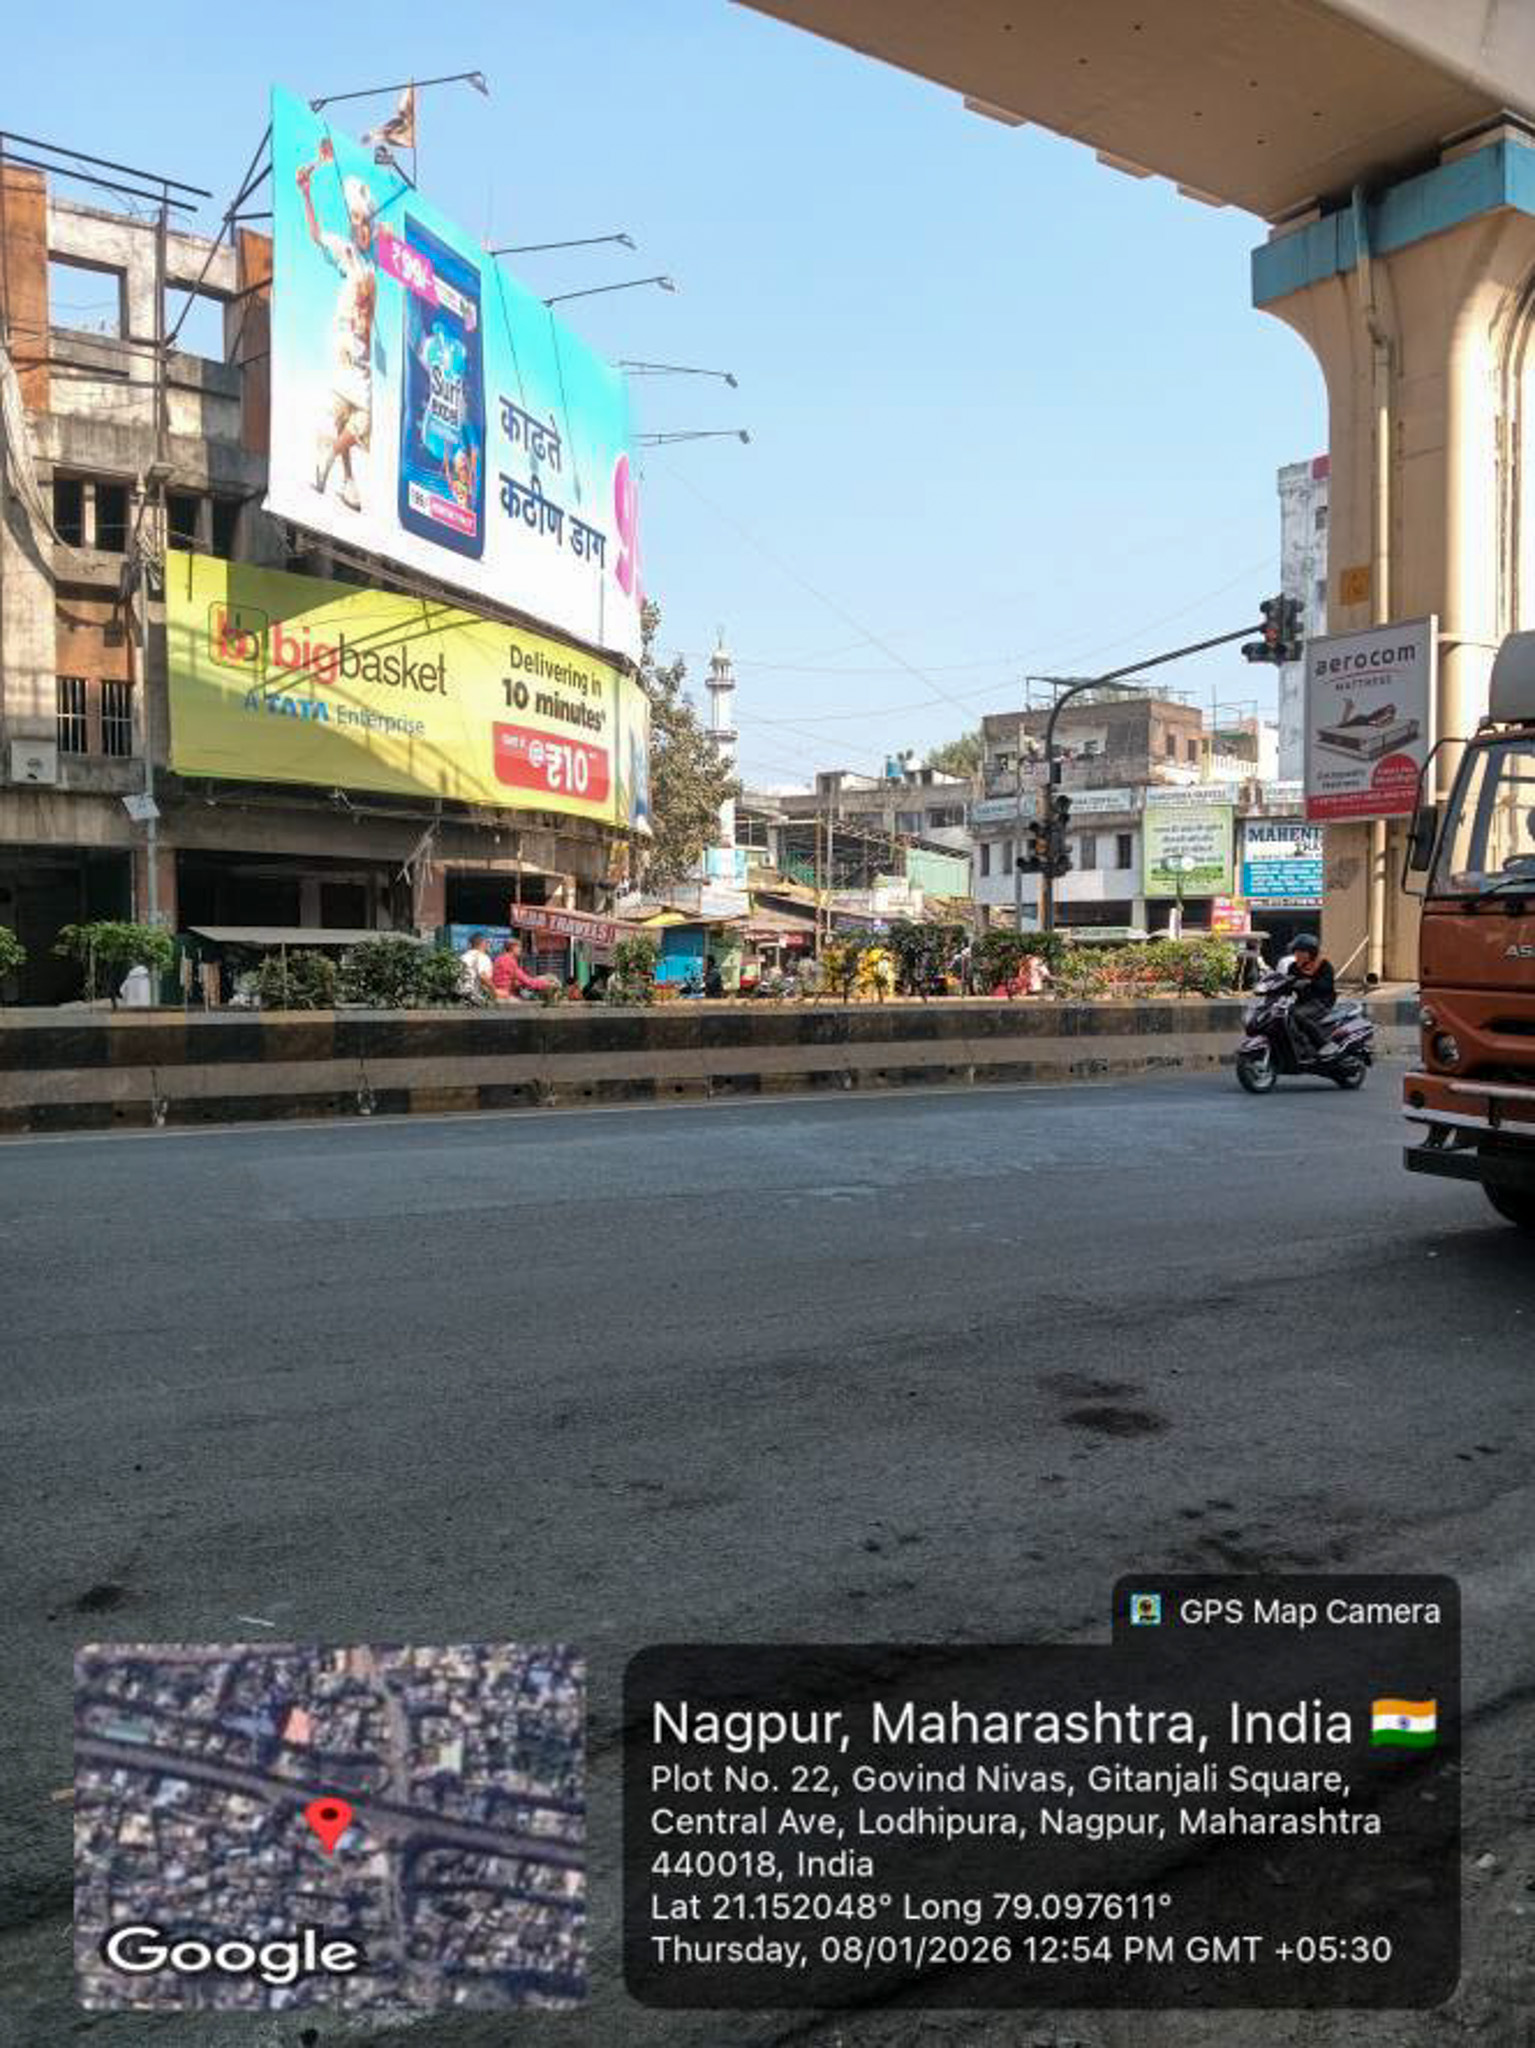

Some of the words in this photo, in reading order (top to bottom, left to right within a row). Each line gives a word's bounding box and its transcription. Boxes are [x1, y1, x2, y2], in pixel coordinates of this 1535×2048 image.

[431, 366, 464, 404] Surf
[499, 473, 564, 547] कठीण
[569, 515, 607, 570] डाग
[271, 619, 447, 697] bigbasket
[510, 644, 588, 696] Delivering
[591, 672, 602, 698] in
[1315, 644, 1416, 677] aerocom
[244, 690, 259, 712] A
[266, 693, 330, 723] TATA
[336, 705, 425, 735] Enterprise
[502, 678, 529, 710] 10
